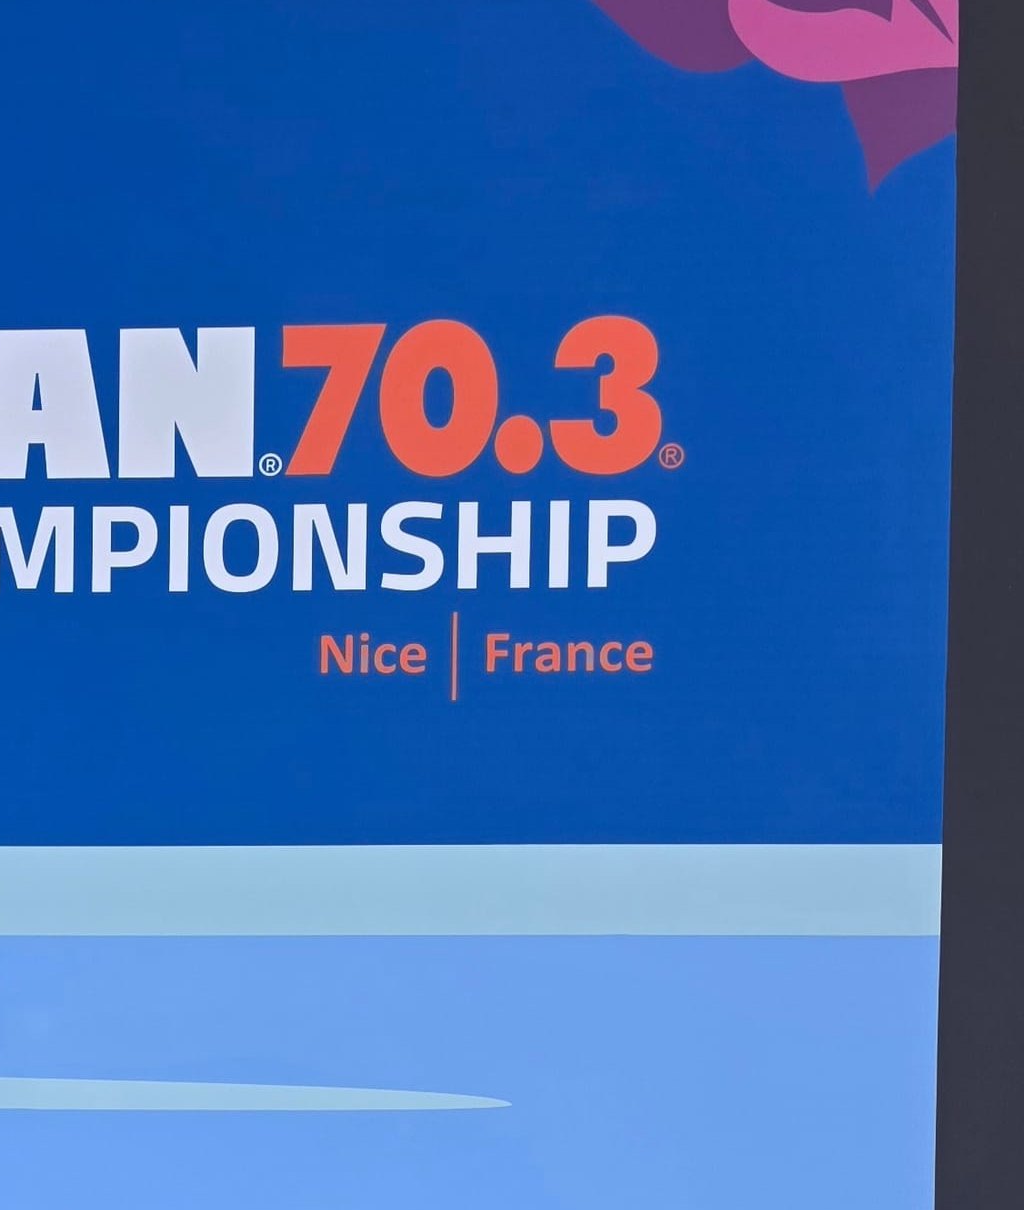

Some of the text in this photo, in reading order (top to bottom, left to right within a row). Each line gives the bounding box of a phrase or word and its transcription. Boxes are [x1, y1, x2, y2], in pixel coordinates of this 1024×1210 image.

[281, 315, 663, 478] 70.3
[319, 632, 654, 675] Nice France
